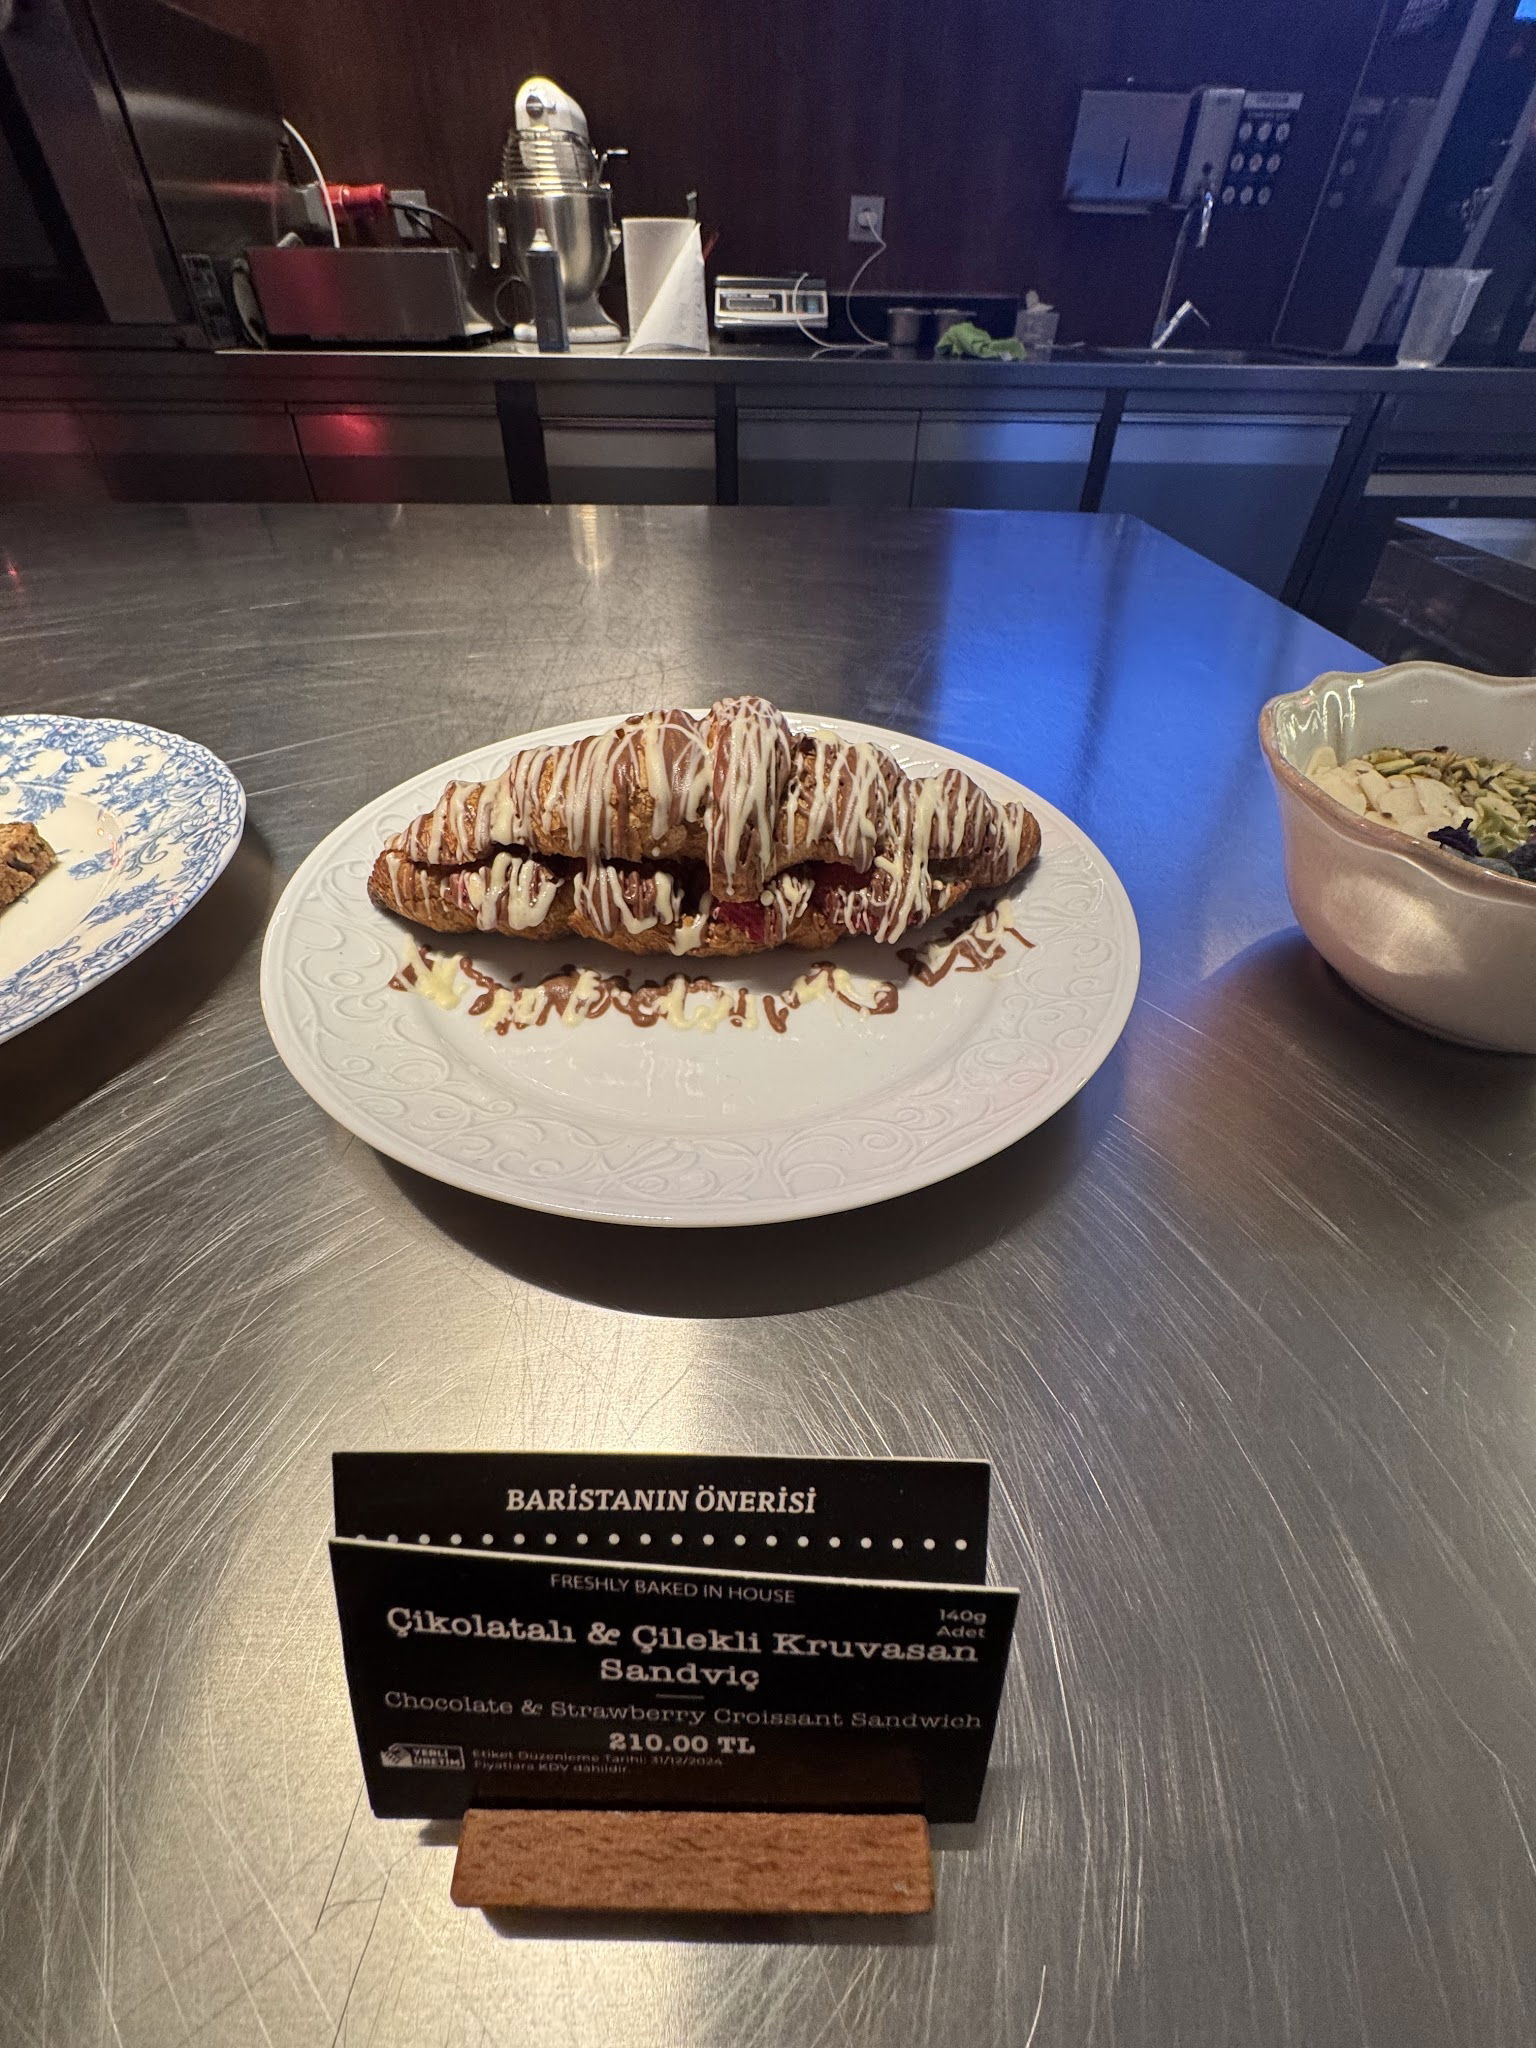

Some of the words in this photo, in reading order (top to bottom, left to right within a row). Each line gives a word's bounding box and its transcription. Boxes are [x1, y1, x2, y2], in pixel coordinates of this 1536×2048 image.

[505, 1484, 690, 1513] BARİSTANIN
[694, 1484, 817, 1515] ÖNERİSİ
[550, 1573, 630, 1593] FRESHLY
[634, 1579, 699, 1597] BAKED
[703, 1584, 723, 1599] IN
[728, 1586, 796, 1604] HOUSE
[936, 1624, 986, 1639] Adet
[938, 1608, 987, 1626] 140g
[386, 1606, 577, 1644] Çikolatalı
[586, 1621, 621, 1646] &
[631, 1624, 762, 1655] Çilekli
[771, 1632, 979, 1663] Kruvasan
[600, 1657, 760, 1692] Sandviç
[384, 1690, 513, 1715] Chocolate
[520, 1699, 543, 1716] &
[551, 1700, 706, 1727] Strawberry
[713, 1708, 844, 1727] Croissant
[851, 1712, 981, 1729] Sandwich
[608, 1732, 709, 1754] 210.00
[716, 1735, 756, 1755] TL
